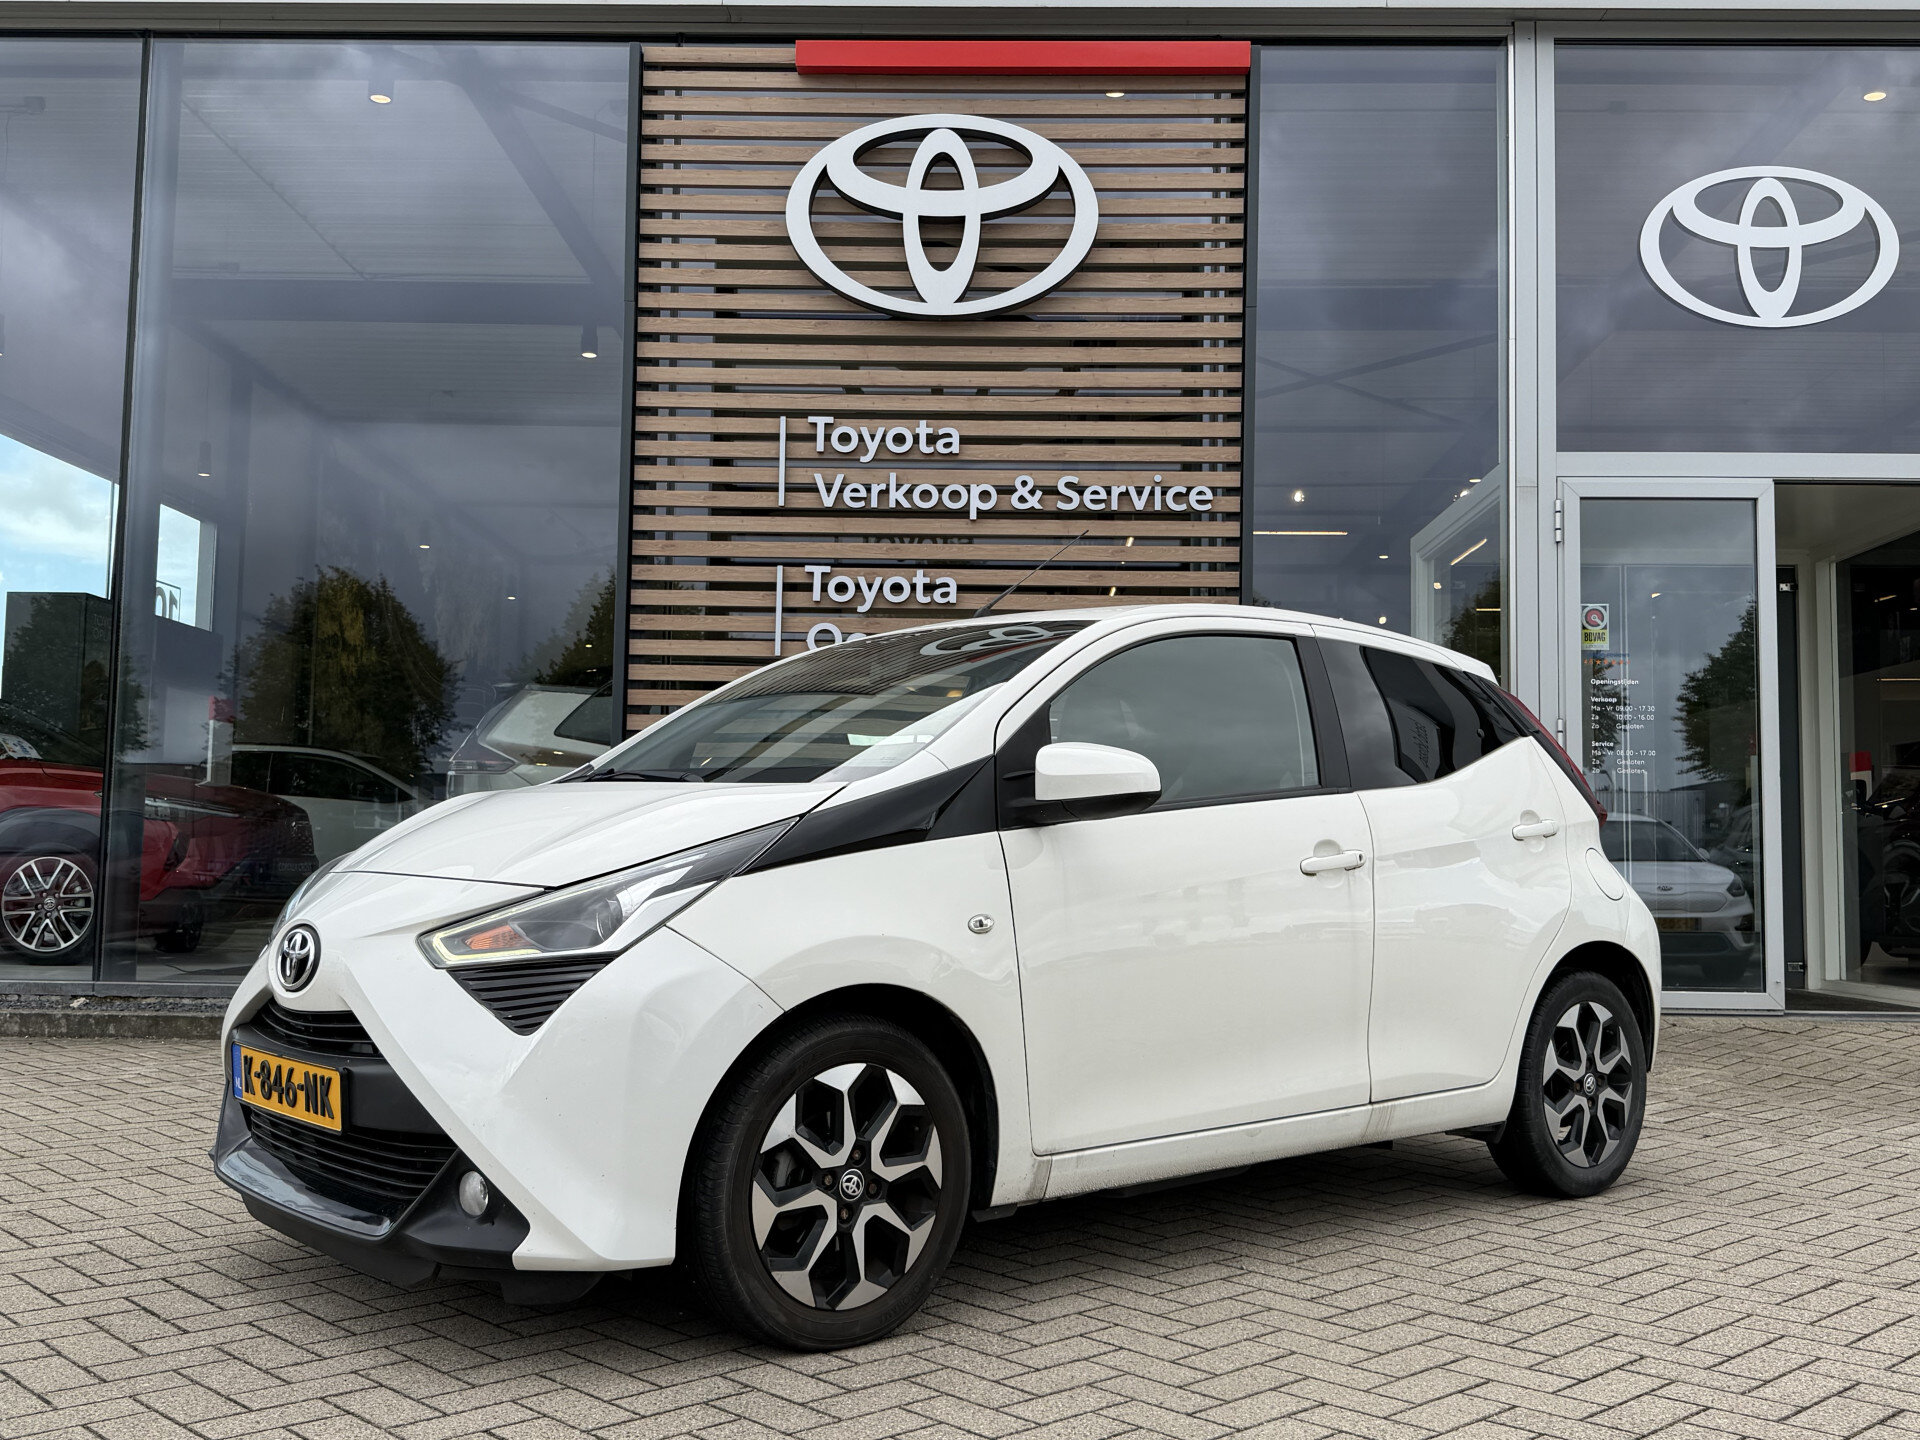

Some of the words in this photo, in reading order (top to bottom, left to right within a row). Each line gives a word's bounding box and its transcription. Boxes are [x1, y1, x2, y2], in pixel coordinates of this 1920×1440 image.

[807, 416, 960, 463] Toyota
[814, 473, 998, 520] Verkoop
[1010, 475, 1043, 511] &
[1056, 474, 1214, 512] Service
[804, 565, 957, 613] Toyota
[1584, 632, 1606, 642] BOVAG
[1590, 678, 1639, 686] Openingstijden
[235, 1078, 242, 1090] NL
[243, 1054, 335, 1120] K-846-NK
